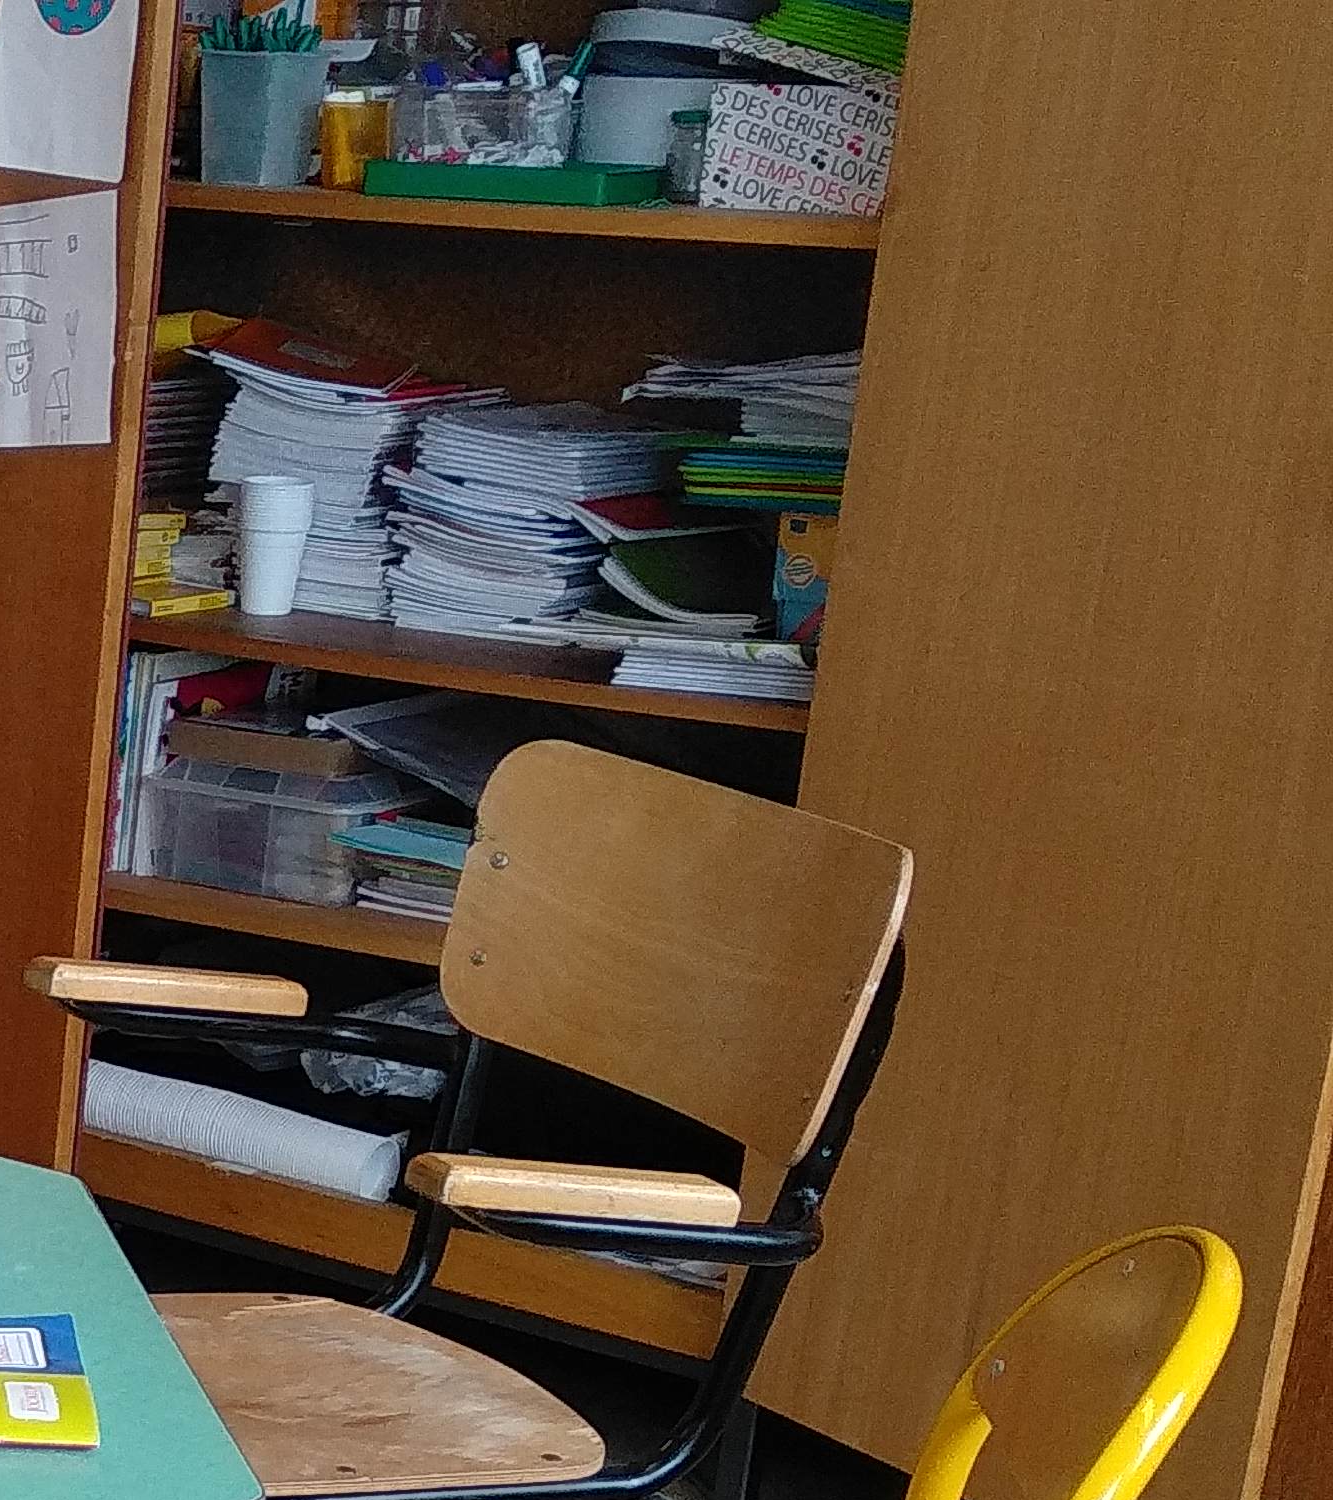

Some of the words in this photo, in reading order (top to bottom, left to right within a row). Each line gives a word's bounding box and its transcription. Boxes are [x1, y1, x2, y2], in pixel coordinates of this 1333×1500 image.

[731, 90, 770, 120] DES
[772, 106, 848, 149] CERISES
[786, 85, 835, 117] LOVE
[733, 119, 809, 163] CERISES
[718, 143, 740, 168] LE
[744, 150, 808, 190] TEMPS
[809, 176, 850, 207] DES
[732, 174, 783, 208] LOVE
[830, 155, 883, 191] LOVE
